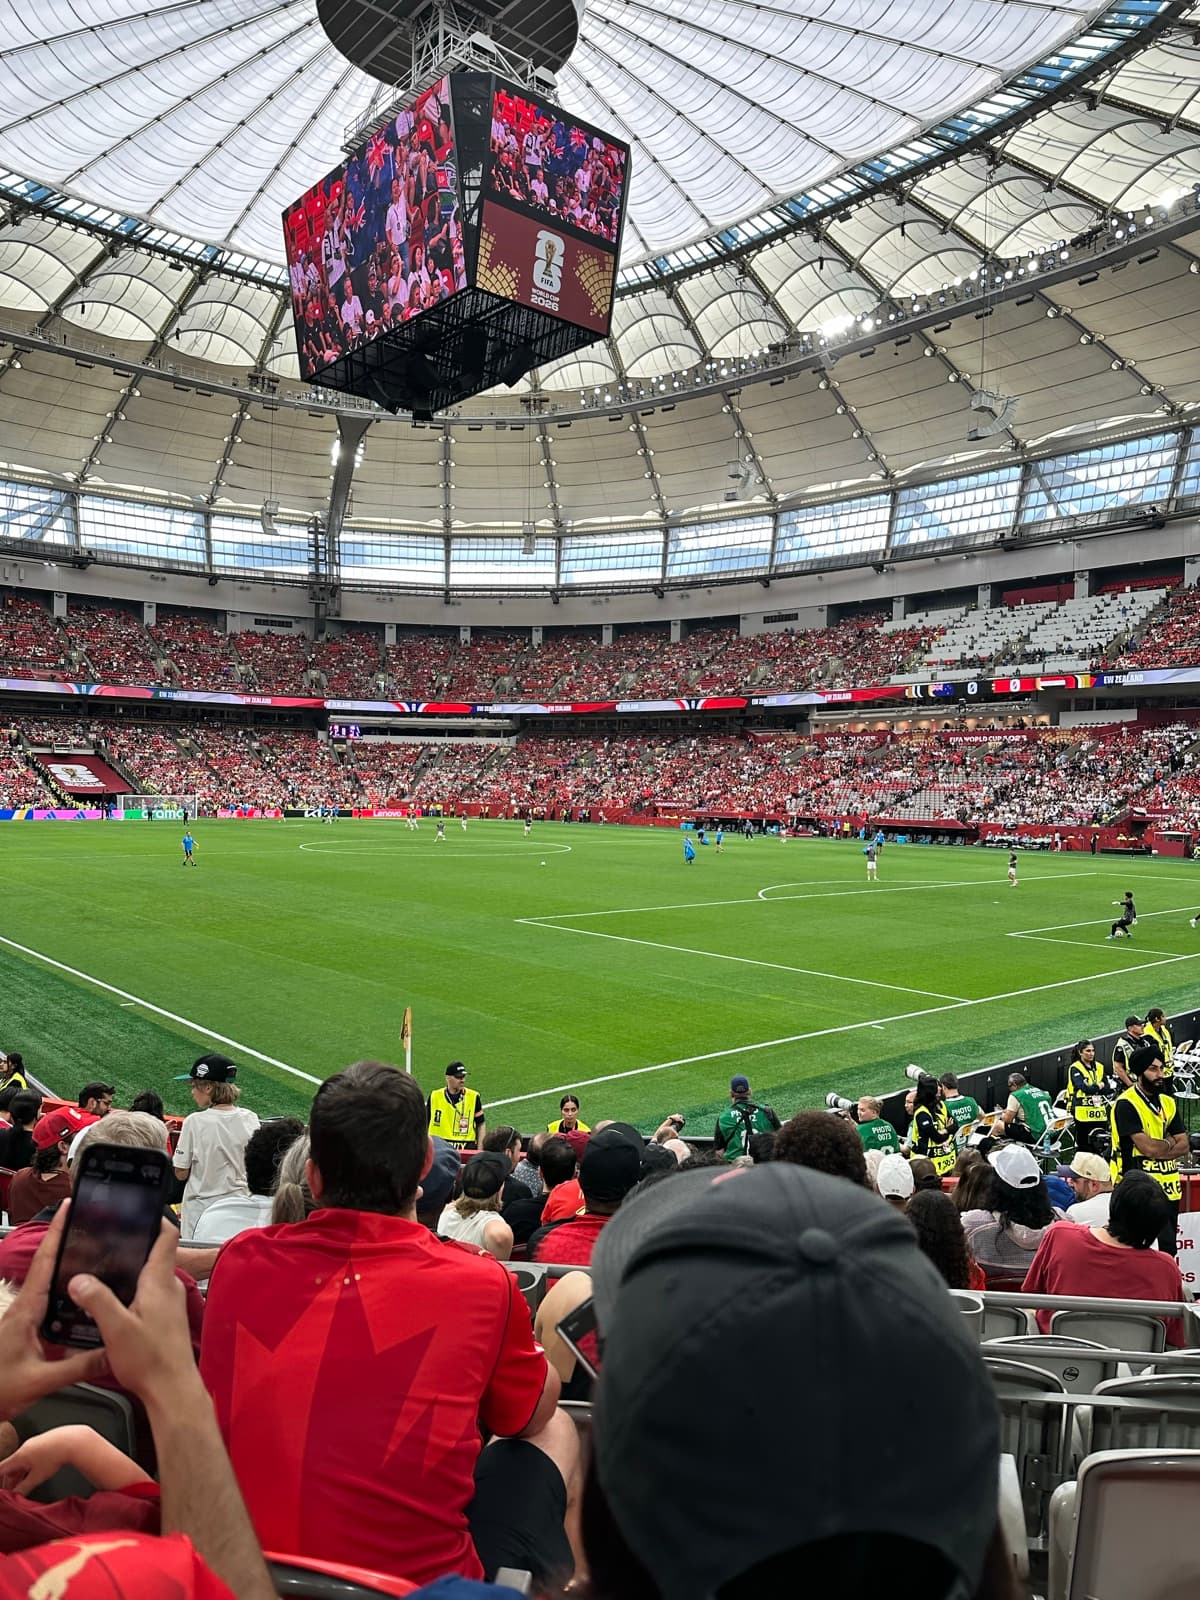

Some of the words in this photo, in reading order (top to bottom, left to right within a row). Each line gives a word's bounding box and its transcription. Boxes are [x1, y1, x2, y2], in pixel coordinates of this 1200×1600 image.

[540, 277, 554, 288] FIFA
[531, 287, 550, 299] WORLD
[550, 294, 560, 302] CUP
[530, 294, 560, 312] 2026
[1114, 674, 1144, 684] ZEALAND
[824, 736, 876, 744] VANOUVER
[988, 735, 1003, 743] CUP
[141, 809, 193, 819] aramc
[373, 809, 402, 817] Lenovo
[951, 1105, 973, 1116] PHOTO
[872, 1126, 892, 1134] PHOTO
[877, 1132, 892, 1141] 0073
